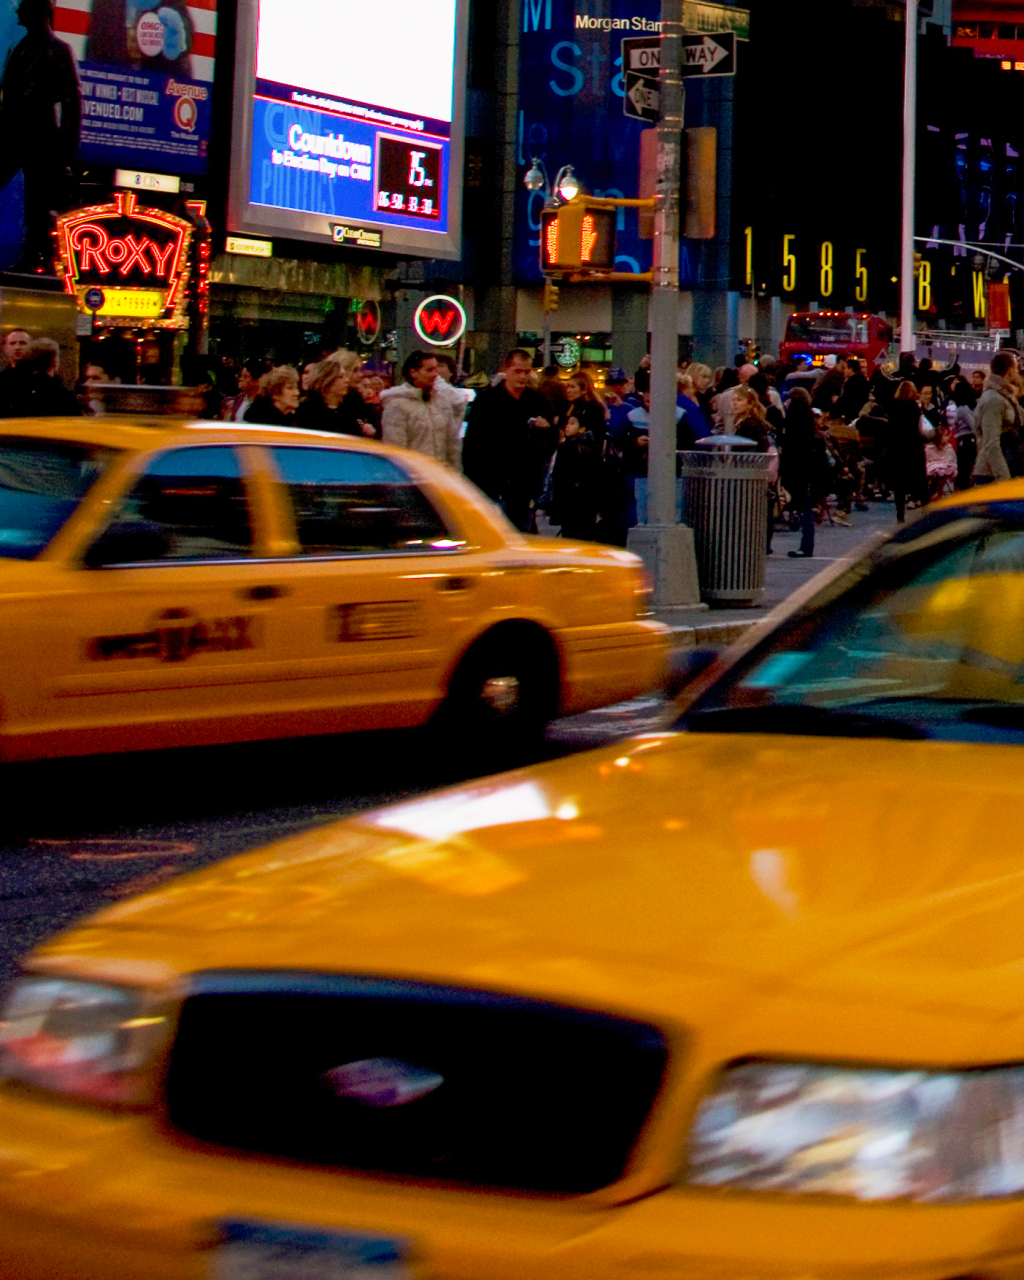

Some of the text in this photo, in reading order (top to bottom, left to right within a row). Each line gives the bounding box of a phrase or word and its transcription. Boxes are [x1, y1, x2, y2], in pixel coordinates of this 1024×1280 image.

[574, 14, 663, 32] Morgan Stan
[639, 46, 718, 67] ON WAY
[165, 79, 208, 101] Avenue
[634, 86, 653, 107] ONE
[174, 96, 198, 133] Q
[288, 123, 372, 165] Countdown
[271, 149, 282, 165] to
[282, 150, 319, 172] Election
[319, 157, 337, 178] Day
[350, 163, 371, 182] CNN
[143, 174, 160, 188] CBS
[70, 224, 175, 276] ROXY
[743, 226, 868, 302] 1585
[419, 309, 455, 334] W
